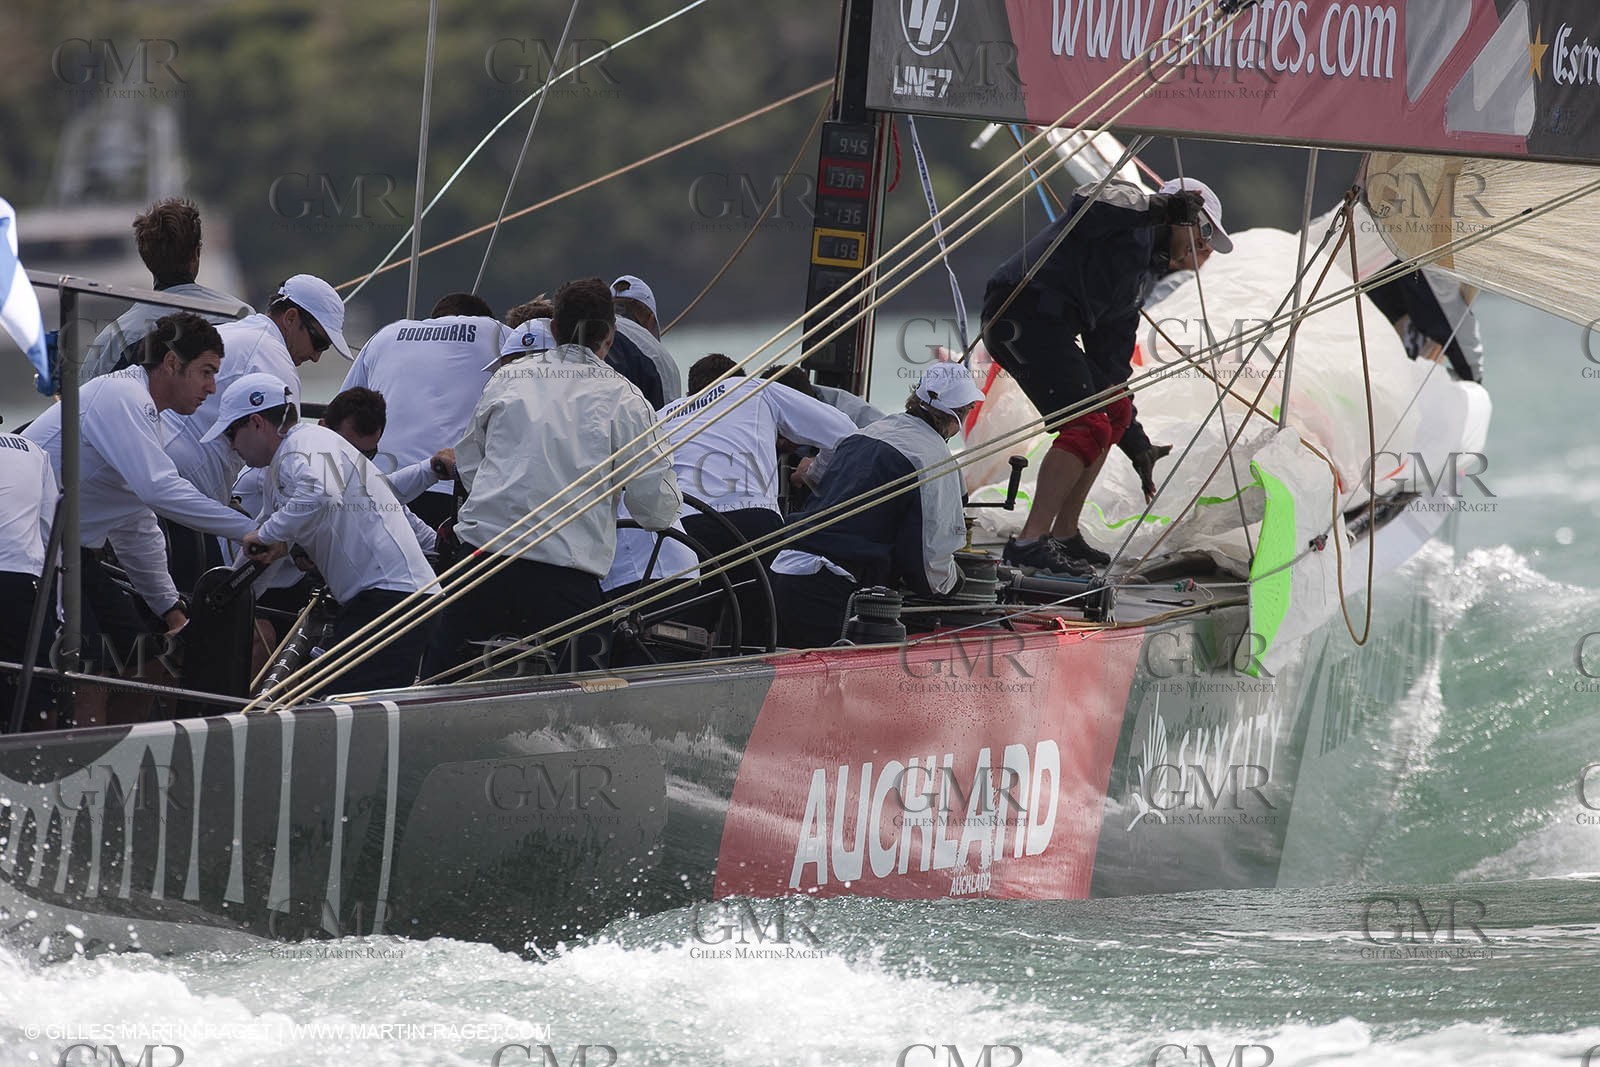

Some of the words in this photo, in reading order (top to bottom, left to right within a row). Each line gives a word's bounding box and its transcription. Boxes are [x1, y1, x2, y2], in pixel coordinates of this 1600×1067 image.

[1553, 22, 1600, 85] Estr
[893, 65, 952, 98] LINE7
[396, 323, 477, 343] BOUBOURAS
